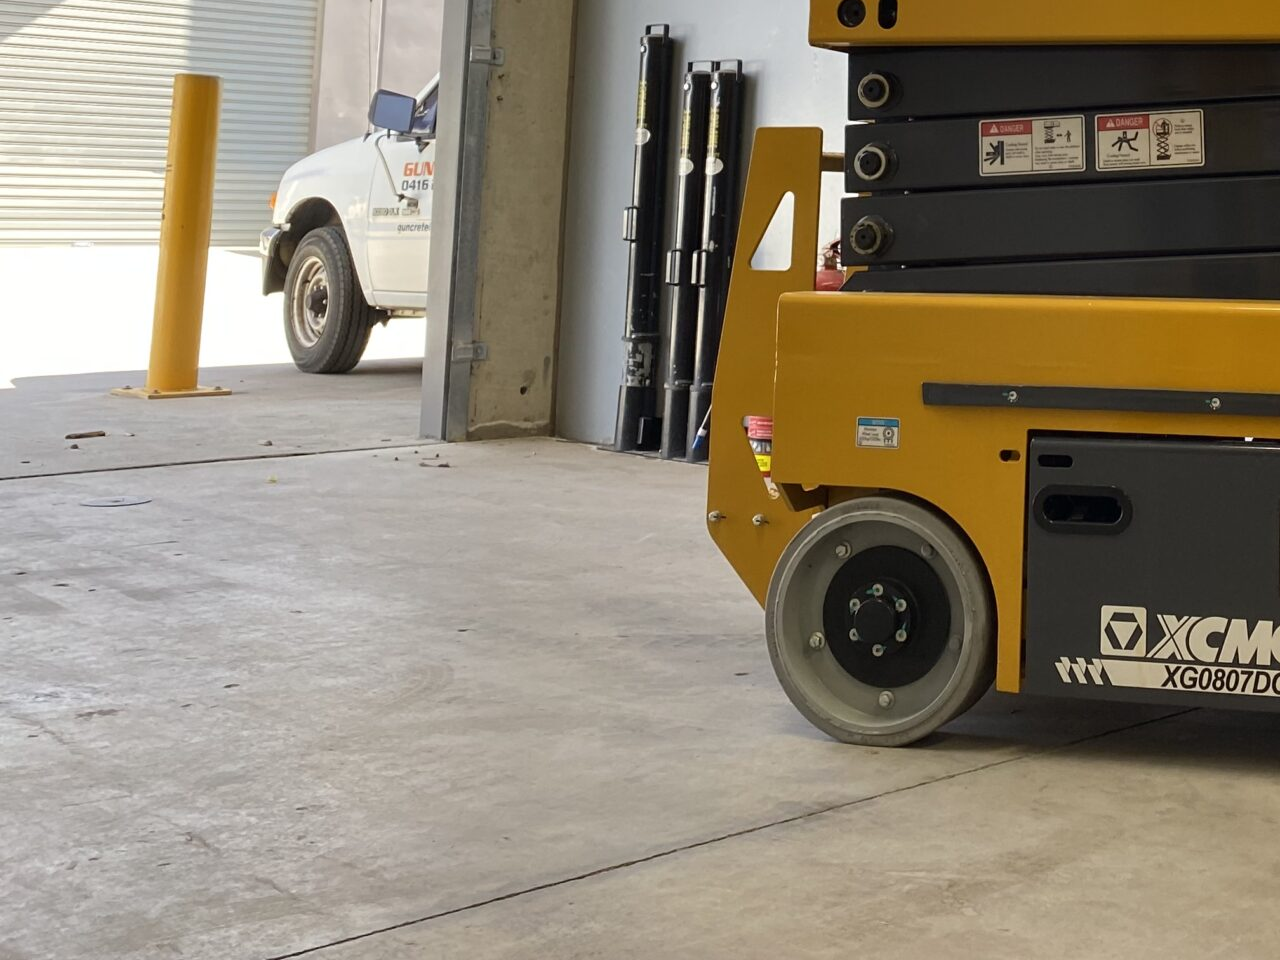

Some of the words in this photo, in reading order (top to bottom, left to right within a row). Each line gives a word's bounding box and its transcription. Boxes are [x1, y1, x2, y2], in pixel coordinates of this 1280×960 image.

[1115, 117, 1144, 127] DANGER
[1000, 124, 1024, 134] DANGER
[401, 179, 429, 191] 0416
